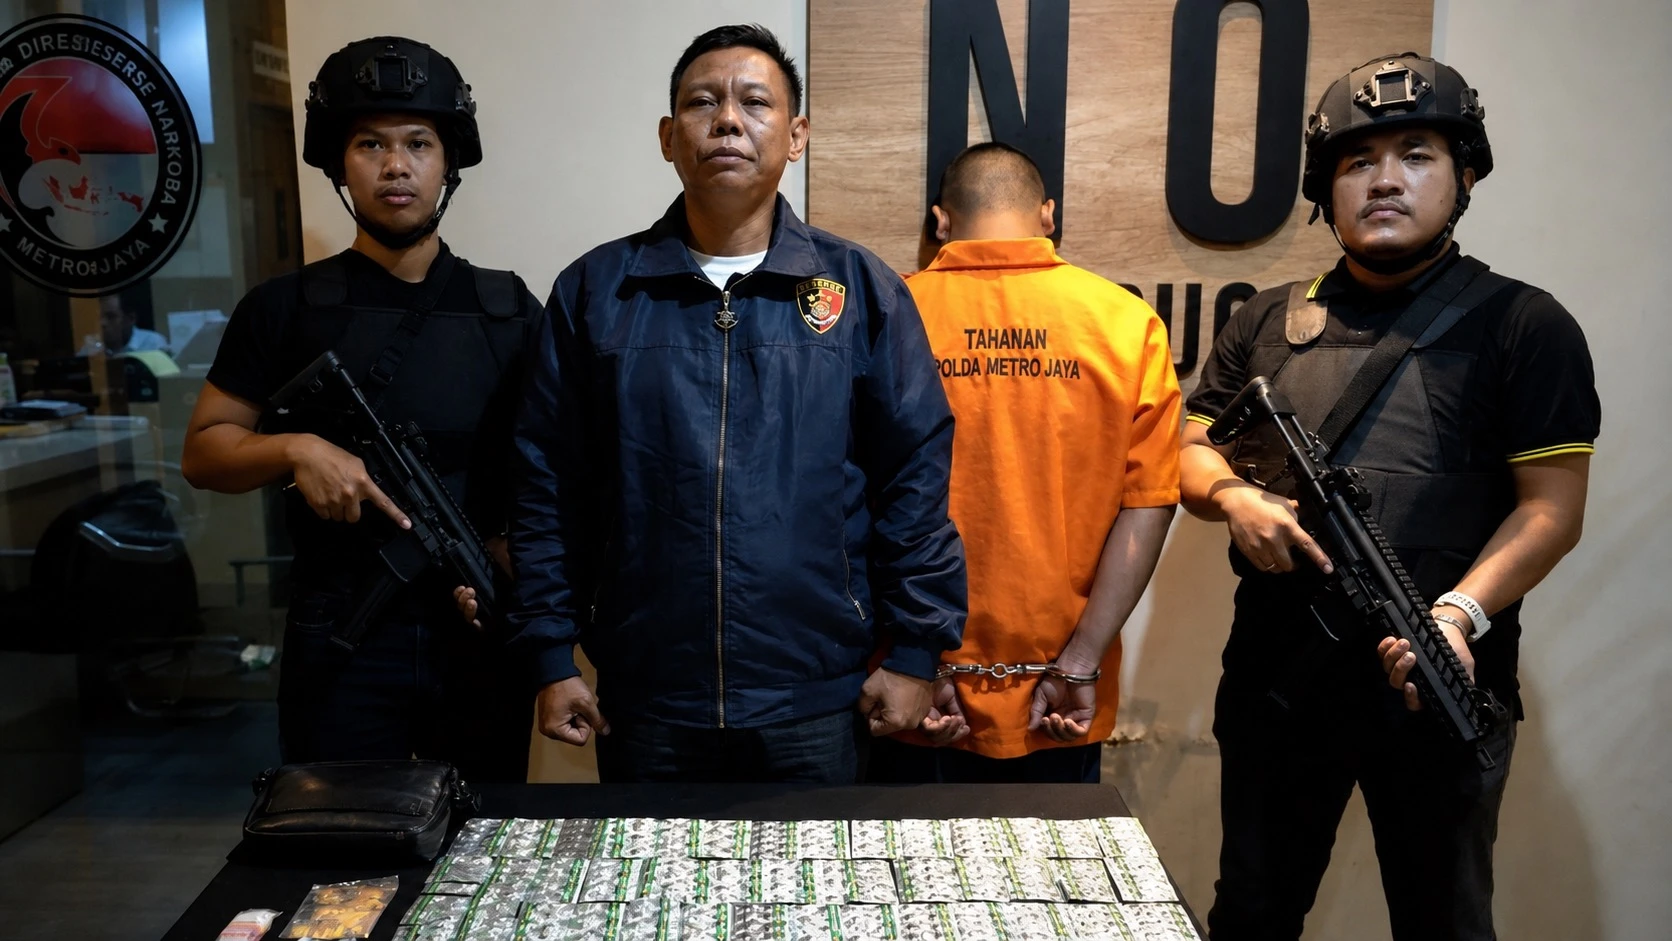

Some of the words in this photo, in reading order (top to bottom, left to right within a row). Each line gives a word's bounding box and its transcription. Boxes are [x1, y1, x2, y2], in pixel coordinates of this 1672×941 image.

[151, 100, 183, 205] NARKOBA
[100, 239, 151, 274] JAYA
[964, 328, 1047, 350] TAHANAN
[986, 357, 1041, 377] METRO
[1044, 358, 1081, 380] JAYA
